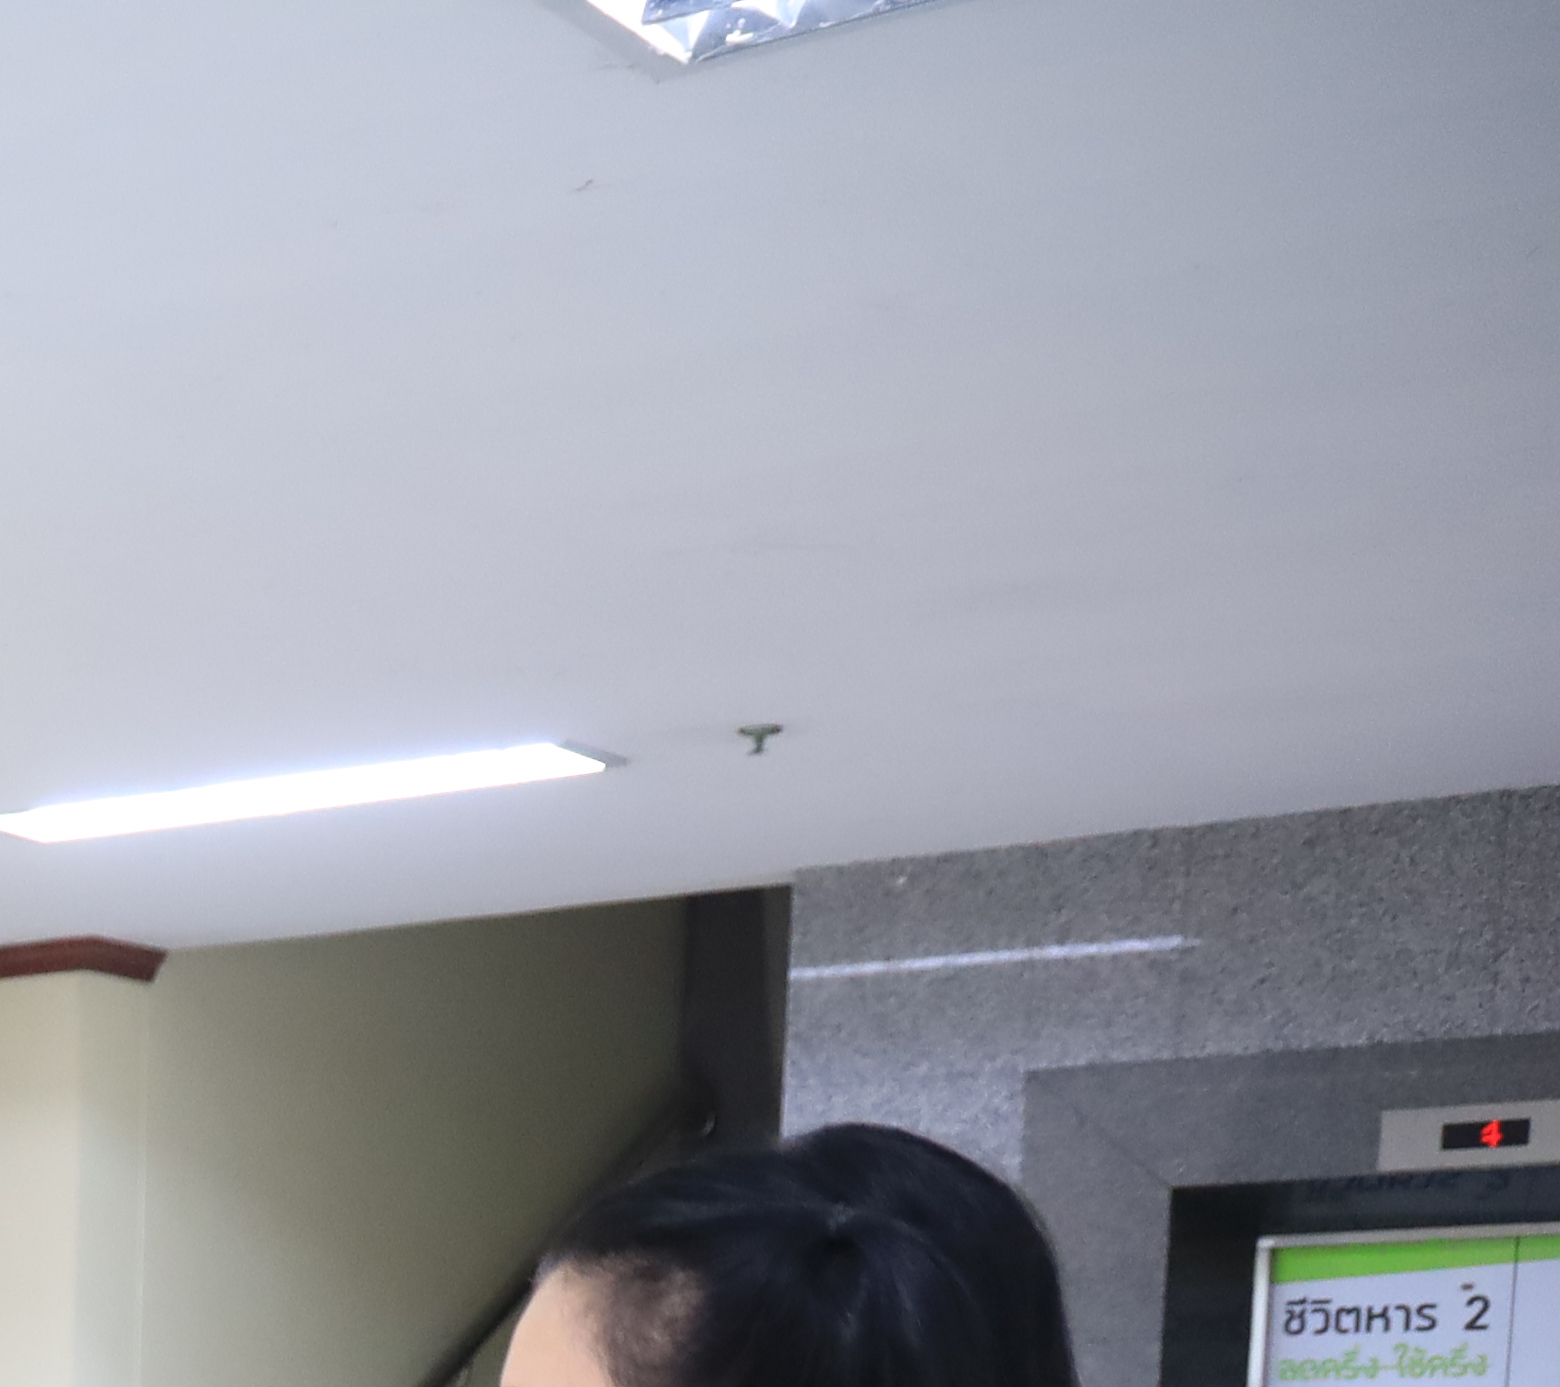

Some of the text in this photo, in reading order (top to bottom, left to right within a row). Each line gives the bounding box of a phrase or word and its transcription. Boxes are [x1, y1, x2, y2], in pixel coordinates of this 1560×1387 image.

[1481, 1119, 1503, 1148] 4
[1284, 1295, 1490, 1335] ชีวิตหาร 2
